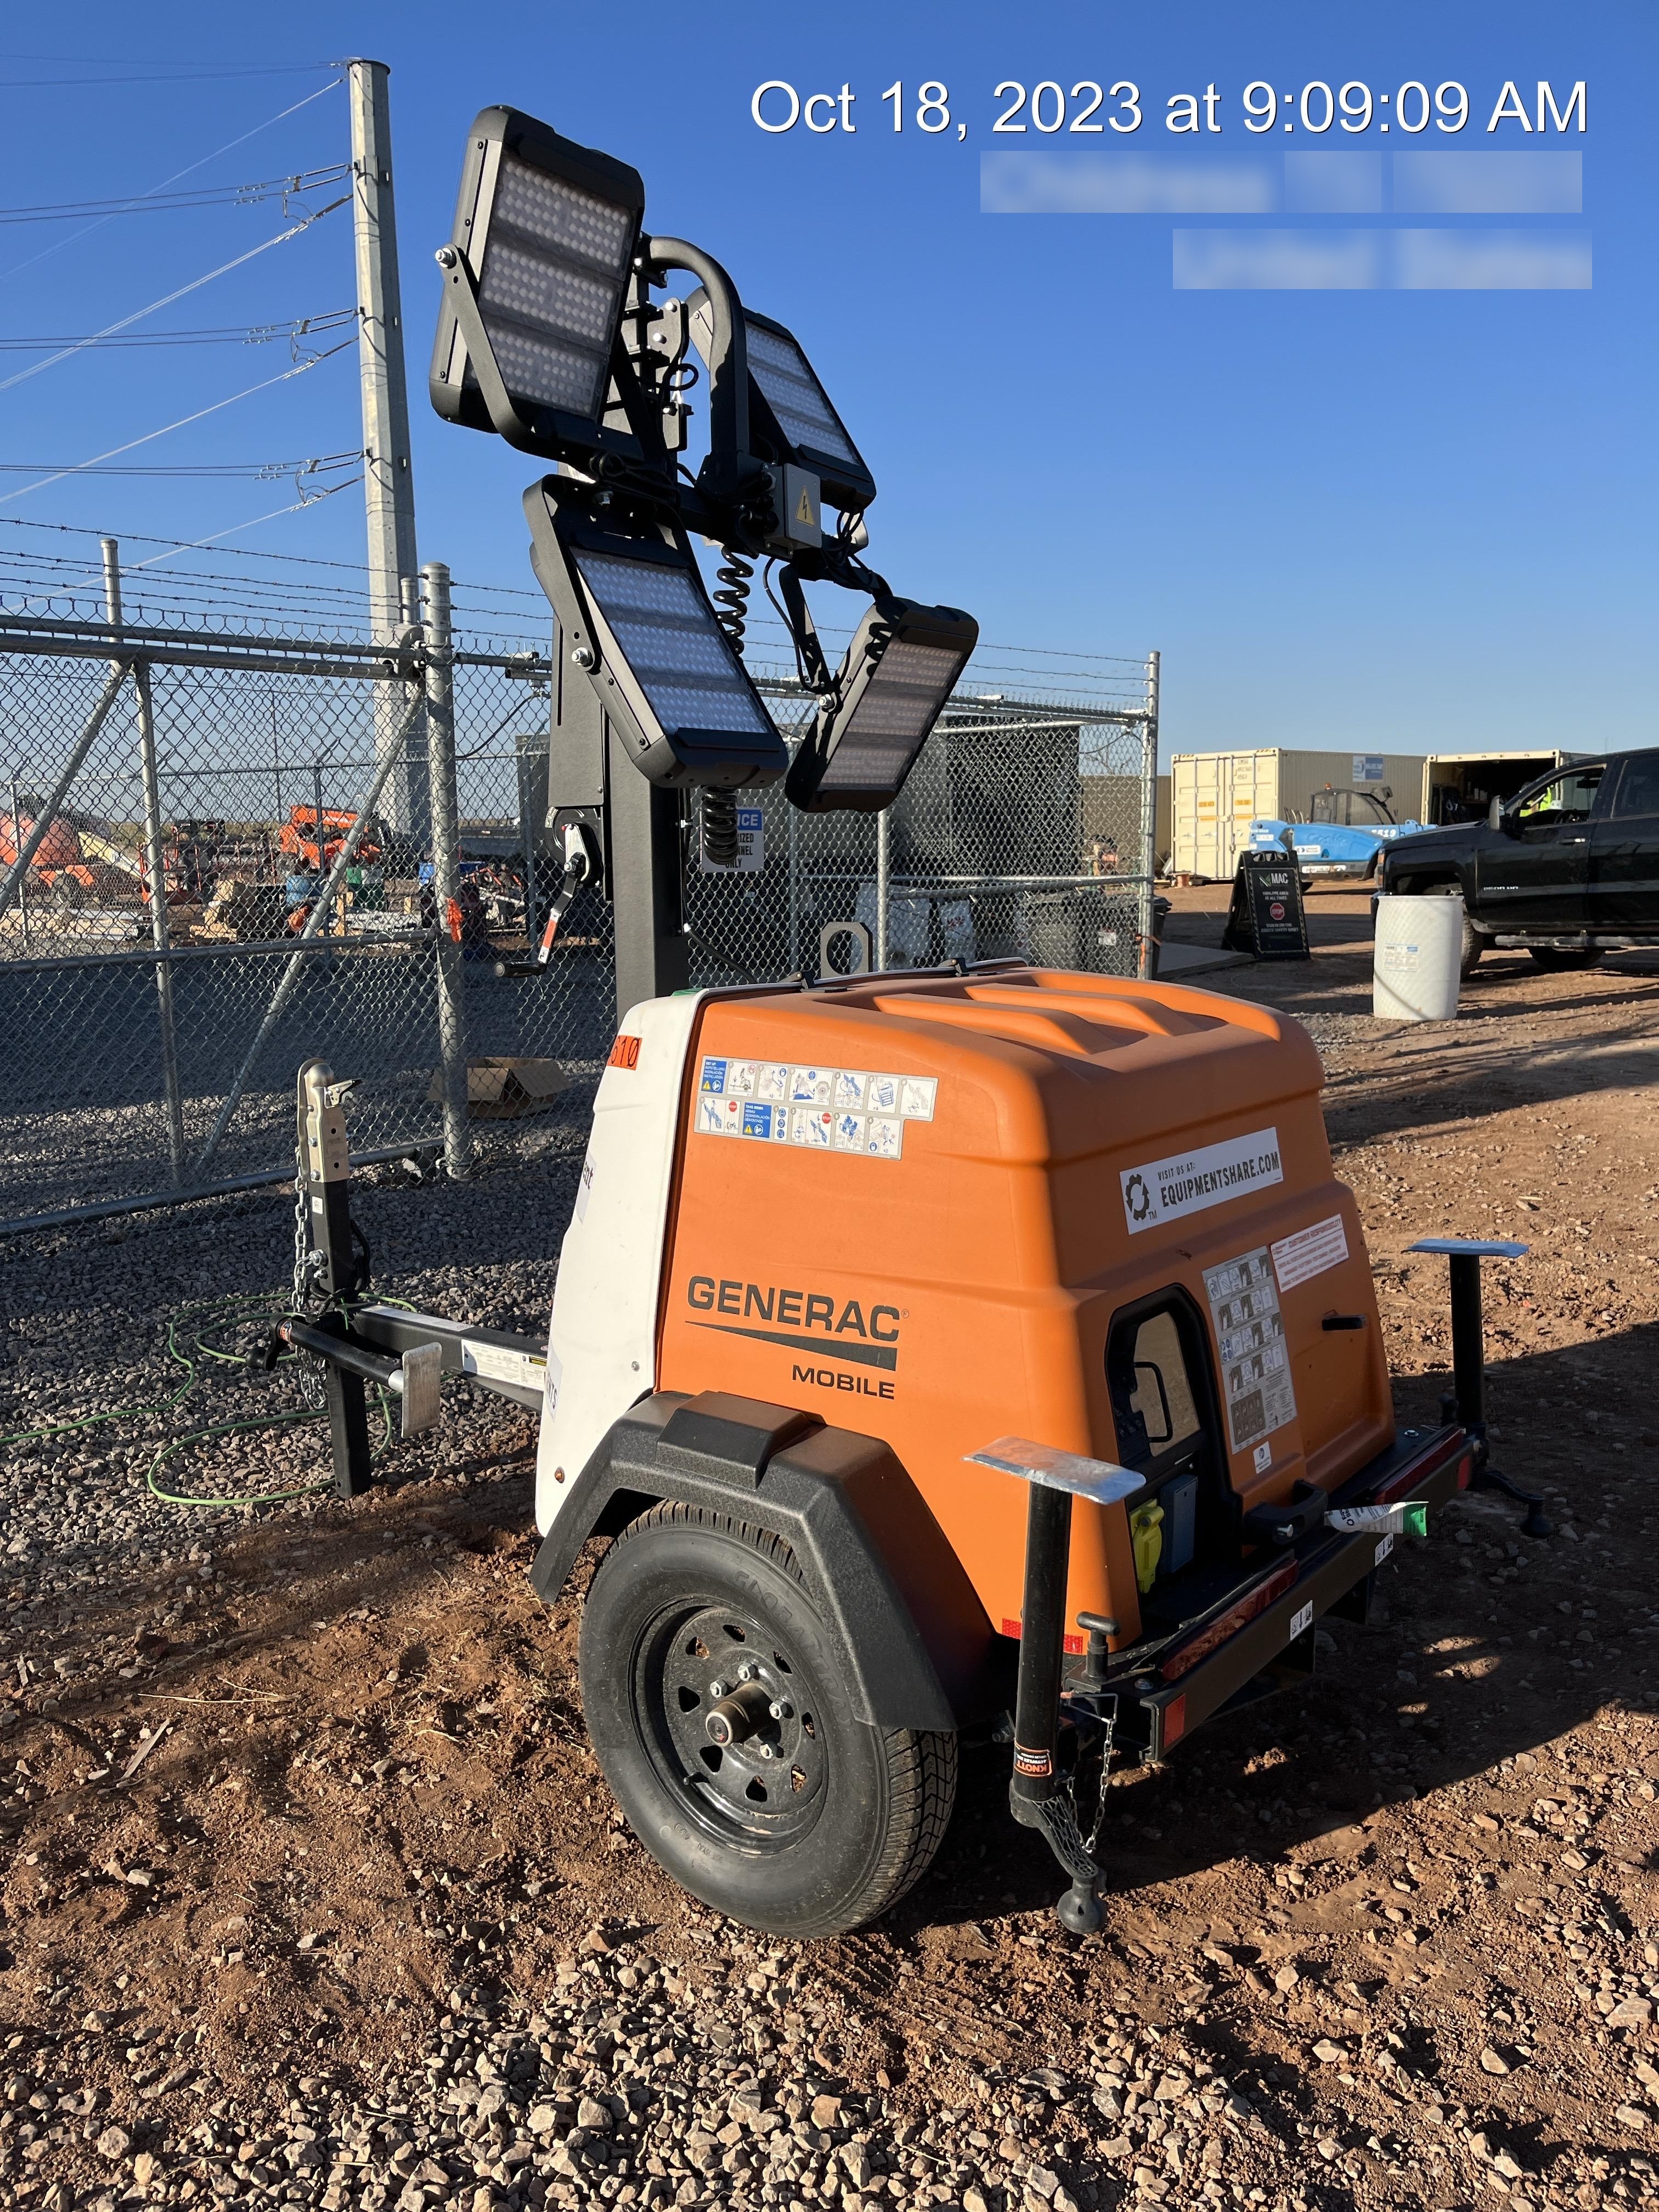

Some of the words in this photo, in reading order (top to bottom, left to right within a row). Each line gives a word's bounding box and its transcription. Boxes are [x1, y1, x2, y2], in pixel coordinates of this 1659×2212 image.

[738, 814, 758, 826] ICE
[1271, 873, 1288, 884] MAC
[1158, 1168, 1174, 1181] VISIT
[1176, 1165, 1184, 1176] US
[1187, 1162, 1195, 1173] AT:
[1161, 1151, 1280, 1207] EQUIPMENTSHARE.COM
[1148, 1210, 1157, 1221] TM
[688, 1276, 900, 1342] GENERAC
[792, 1364, 895, 1400] MOBILE
[1017, 1759, 1047, 1773] KNOTT
